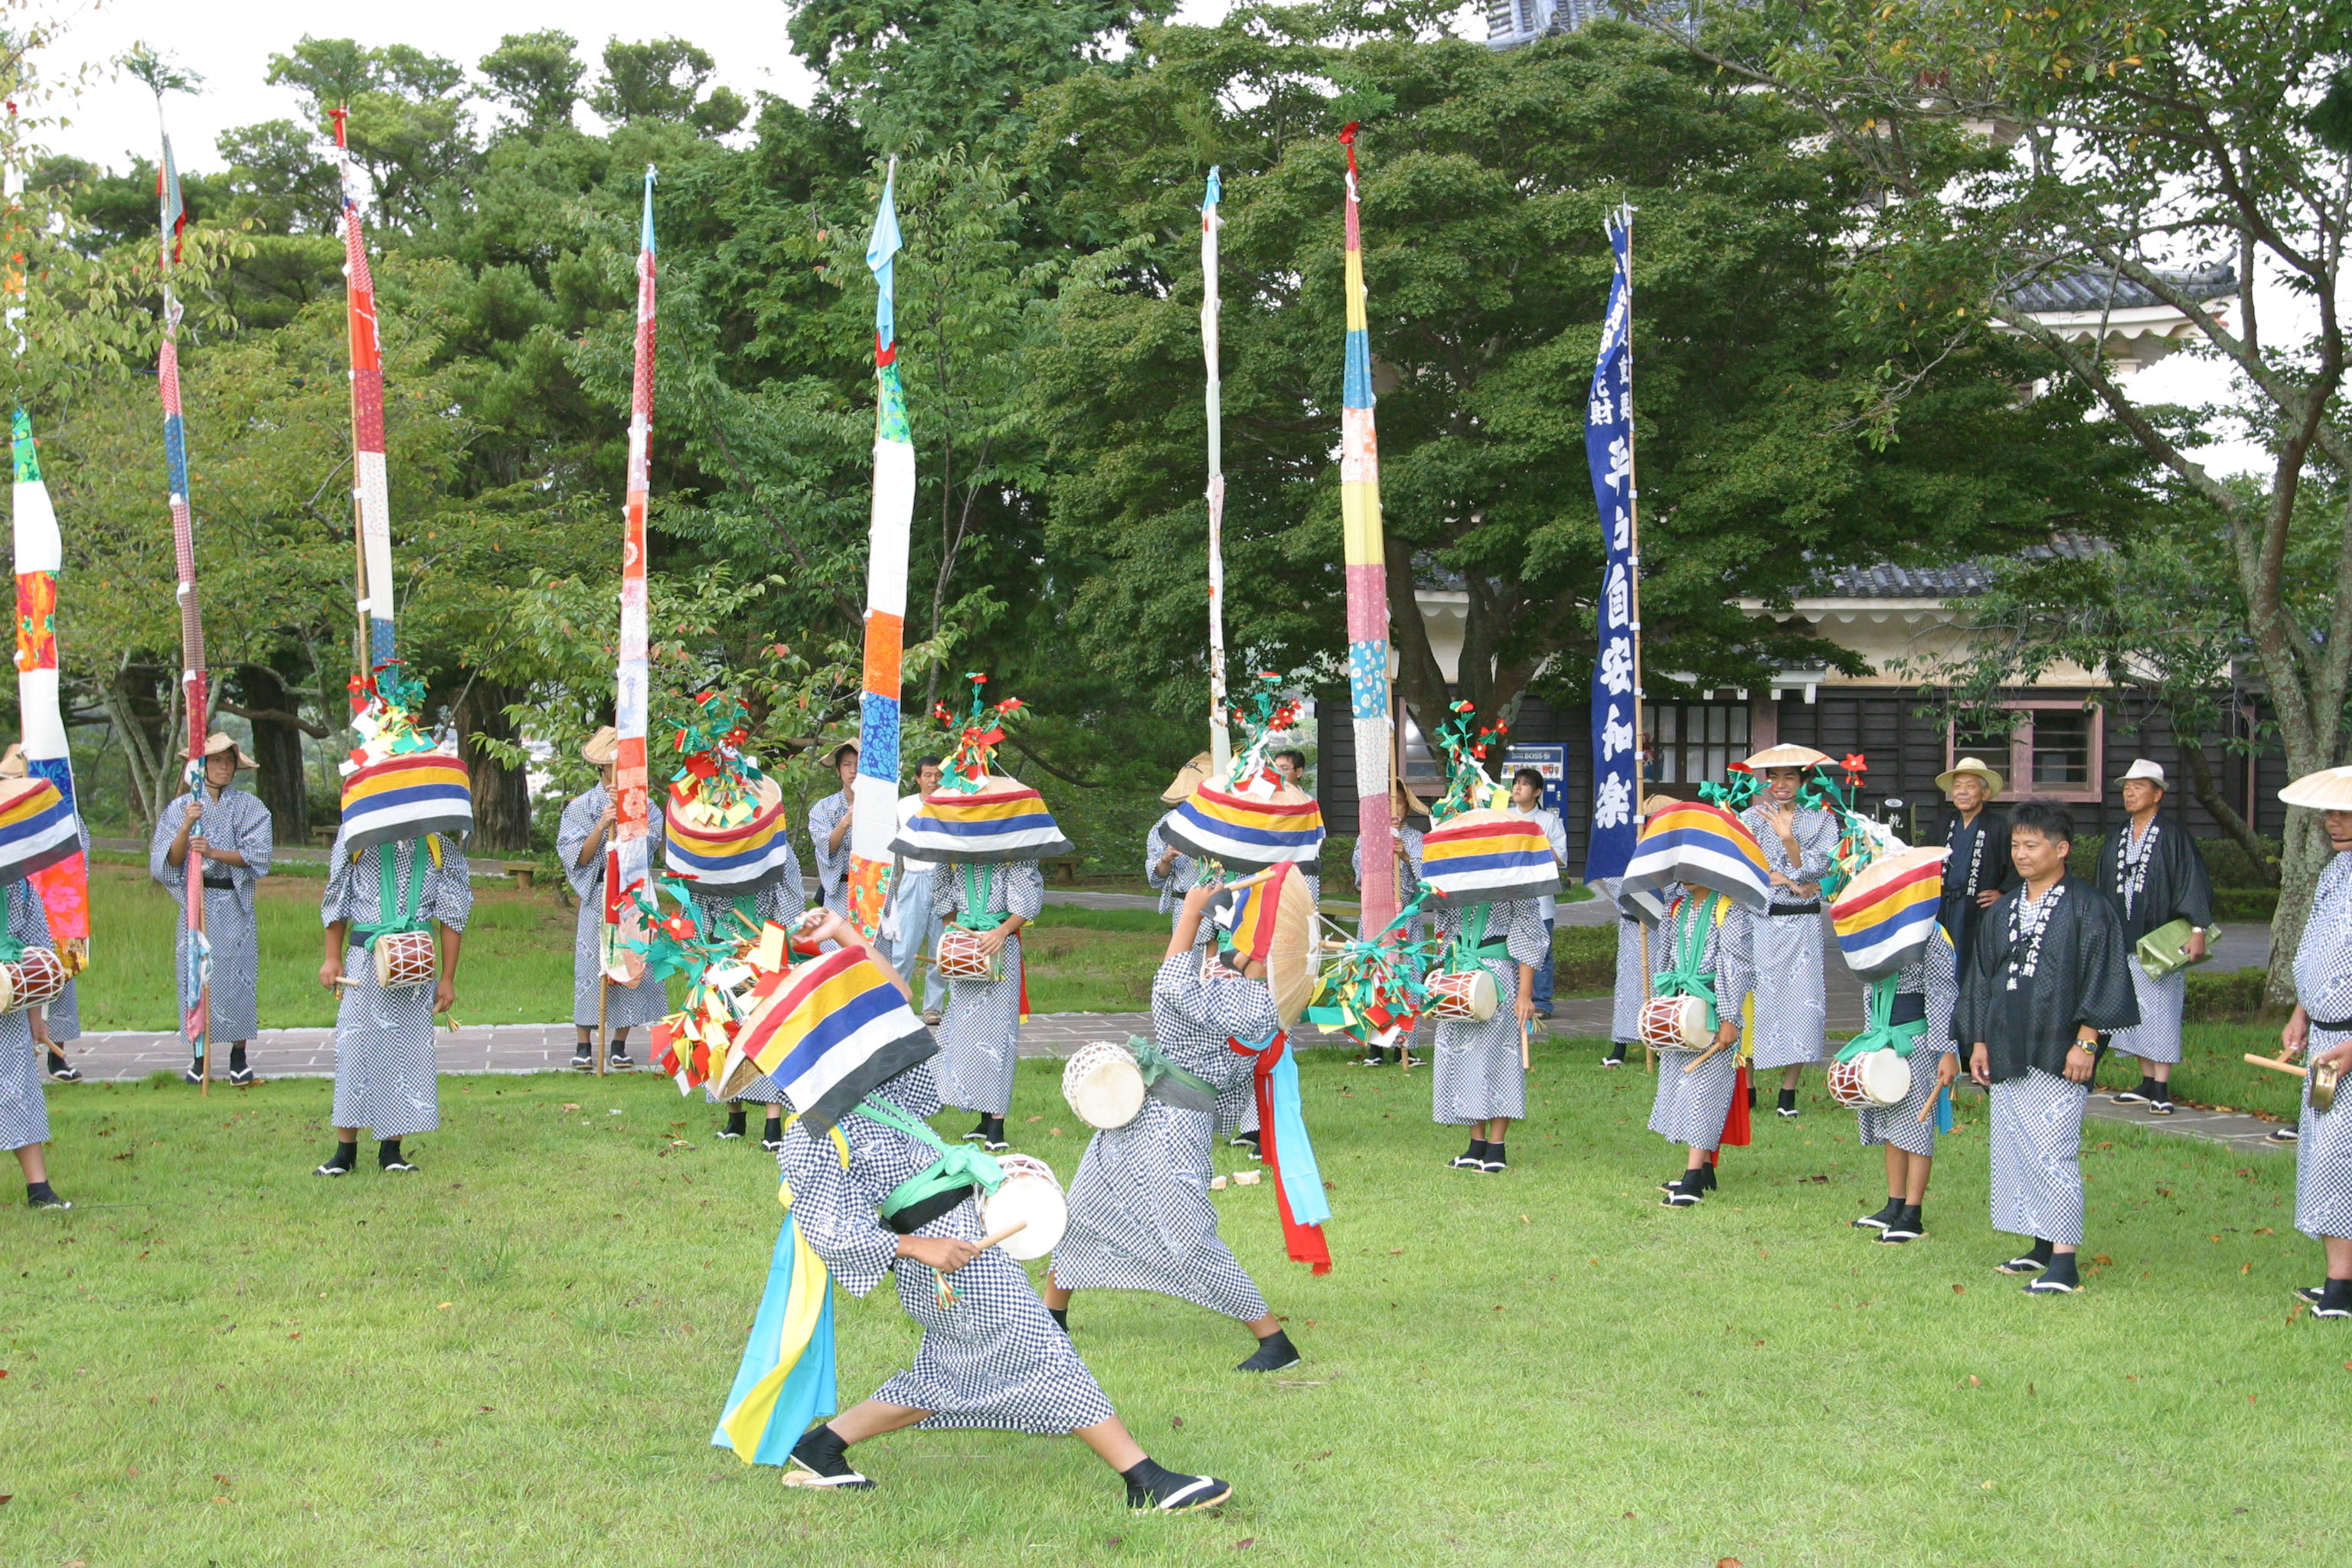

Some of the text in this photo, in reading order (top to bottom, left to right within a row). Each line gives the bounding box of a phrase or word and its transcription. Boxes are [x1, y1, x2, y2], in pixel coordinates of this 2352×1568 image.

[1966, 829, 1986, 897] 無形民俗文化財
[2134, 825, 2160, 893] 無形民俗文化財
[2022, 884, 2066, 978] 無形民俗文化財
